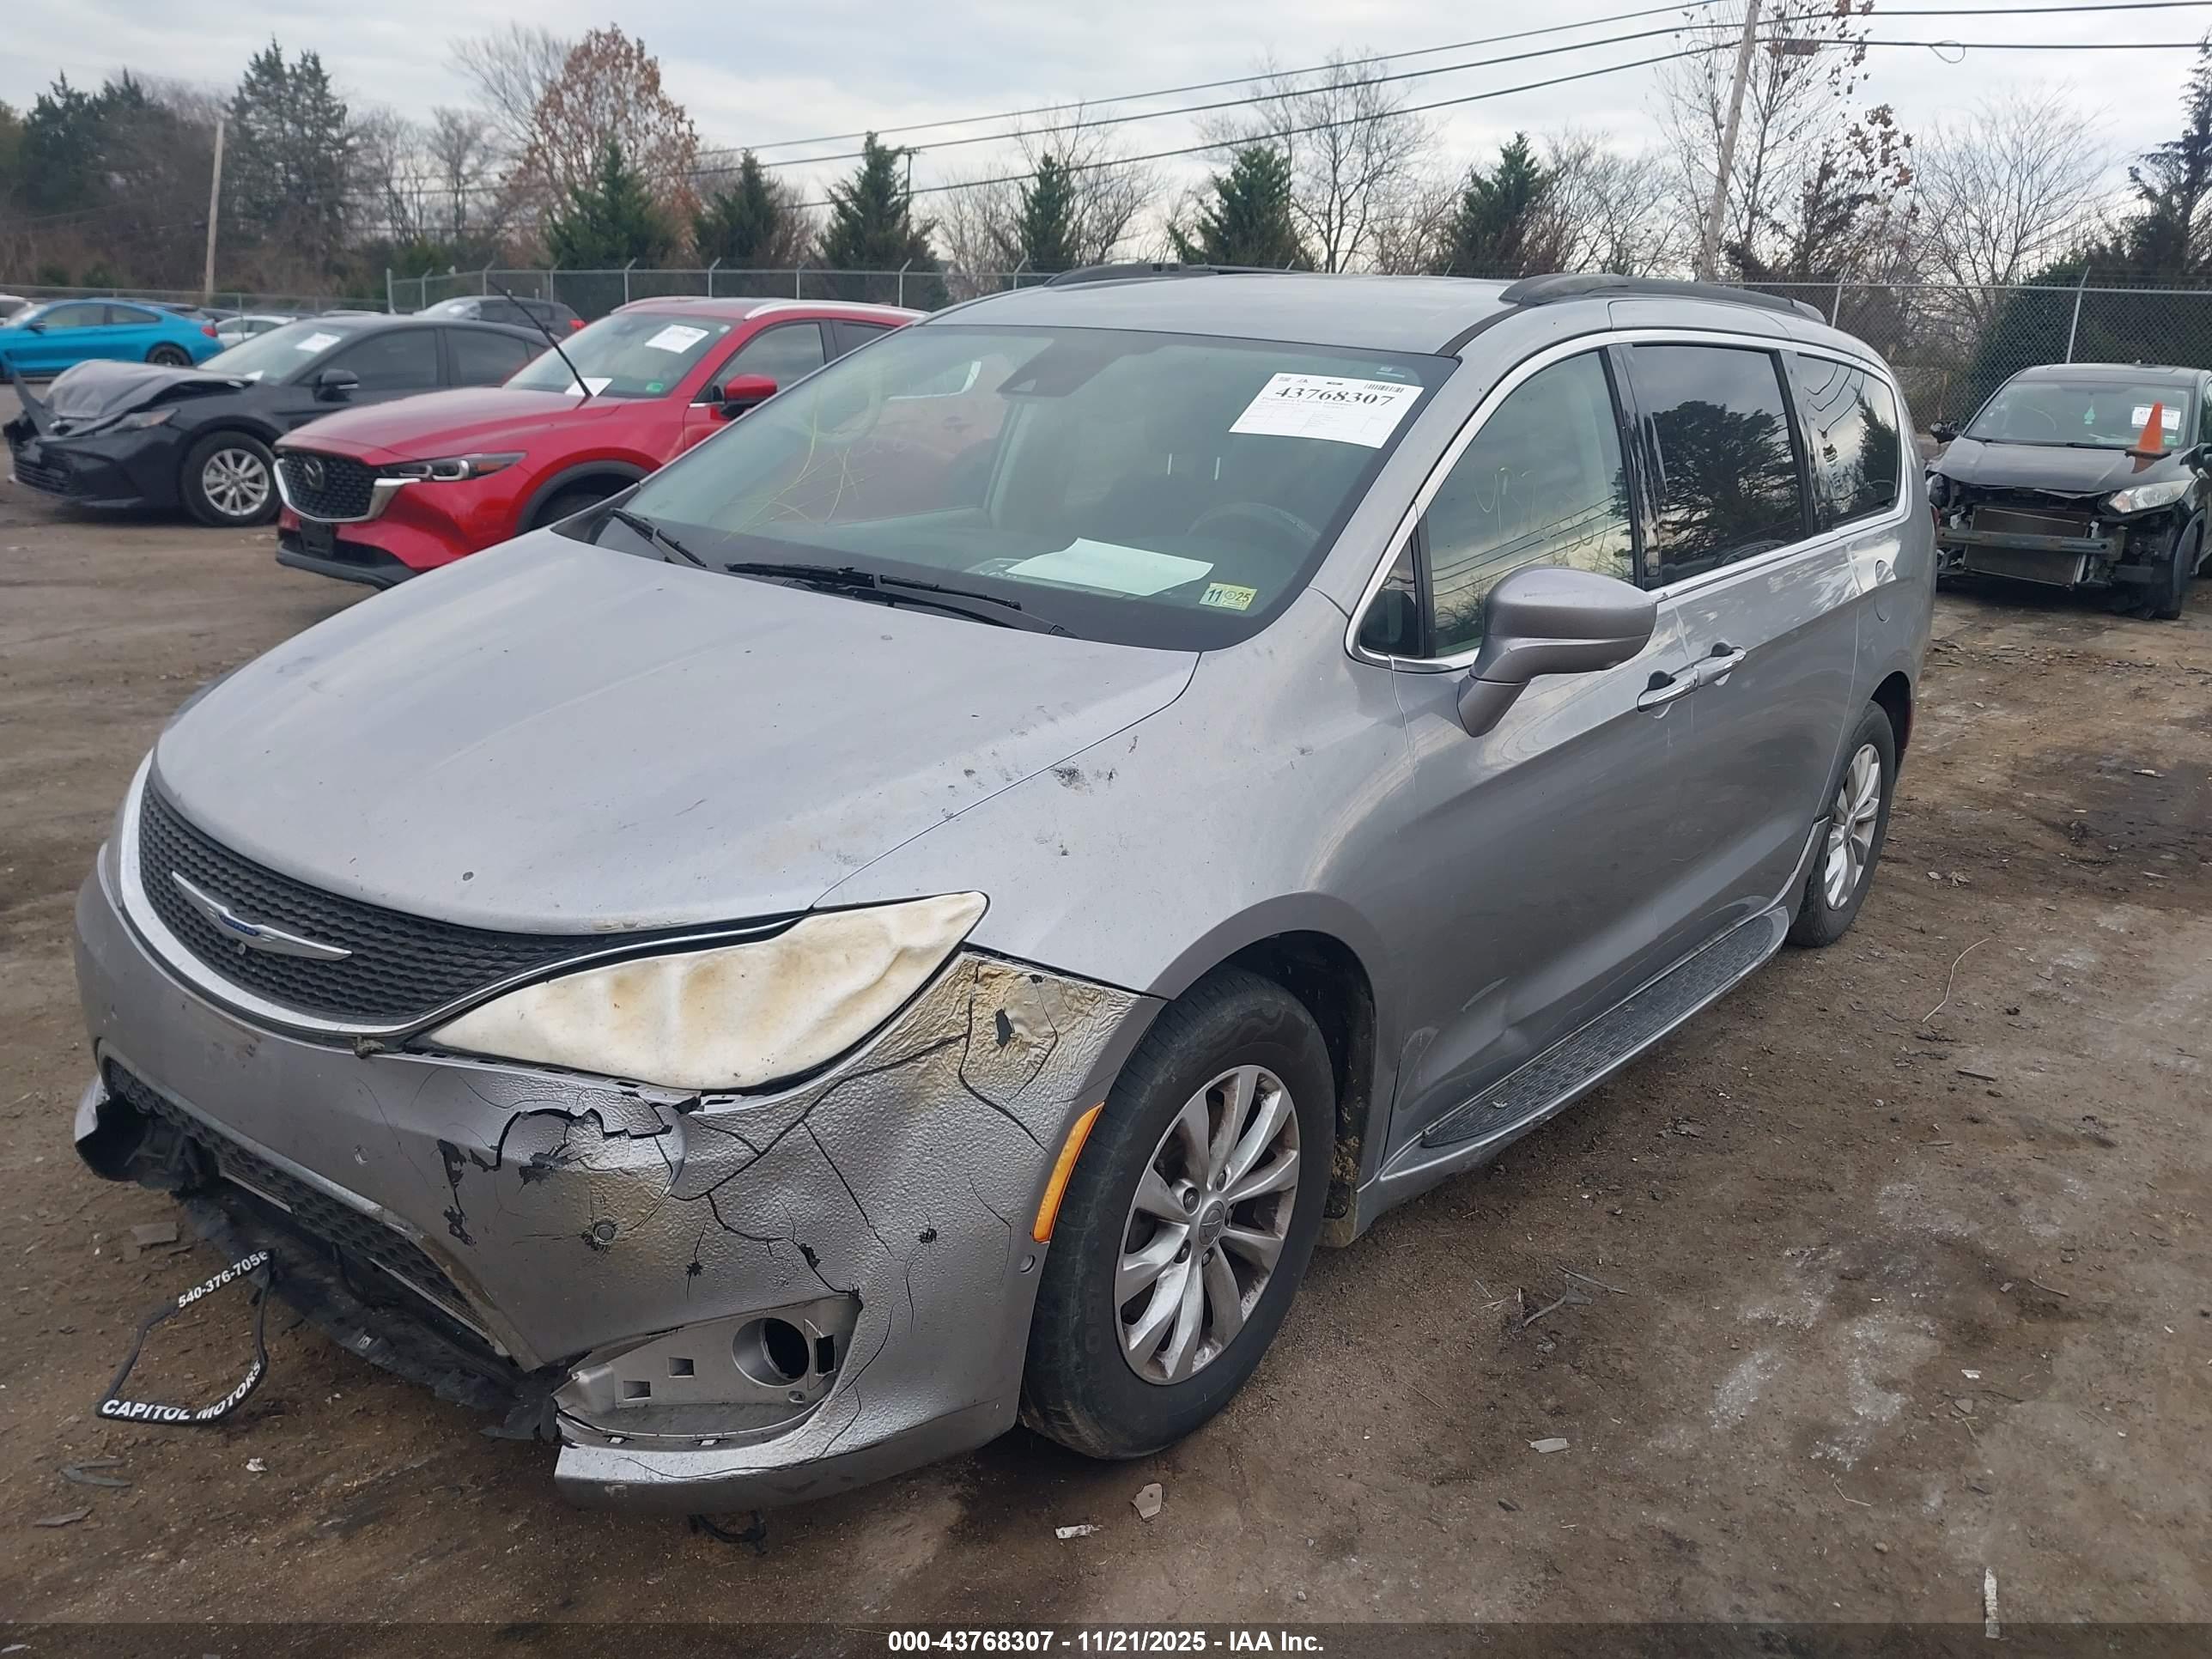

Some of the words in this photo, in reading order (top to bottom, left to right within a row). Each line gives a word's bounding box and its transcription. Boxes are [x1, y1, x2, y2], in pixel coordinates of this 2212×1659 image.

[1276, 386, 1395, 406] 43768307
[1207, 588, 1224, 603] 11
[1235, 592, 1251, 603] 25
[101, 1399, 191, 1420] CAPITOL
[196, 1359, 262, 1420] MOTORS
